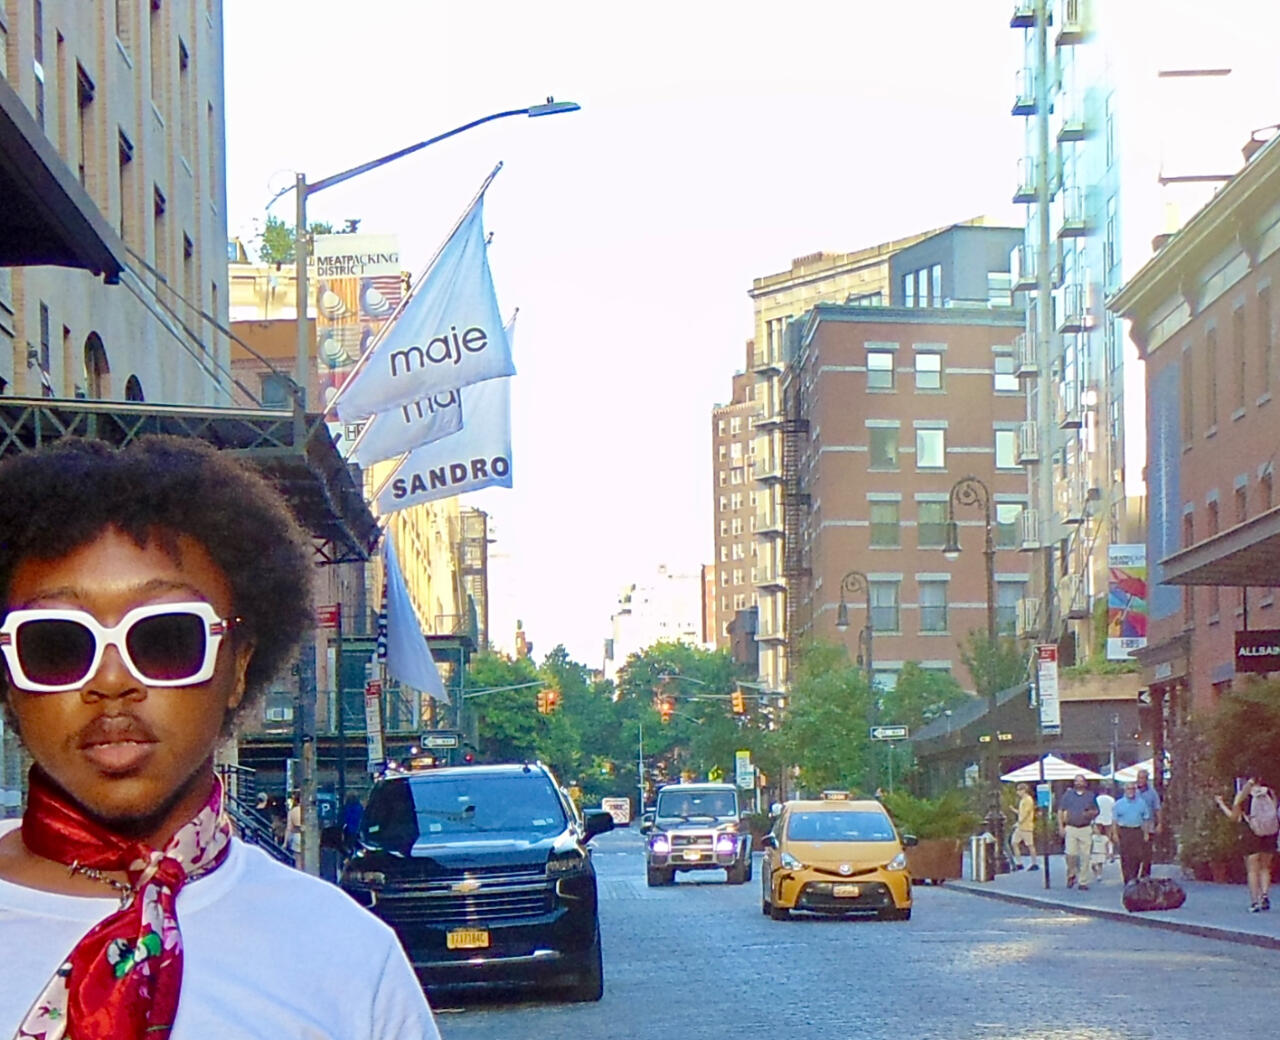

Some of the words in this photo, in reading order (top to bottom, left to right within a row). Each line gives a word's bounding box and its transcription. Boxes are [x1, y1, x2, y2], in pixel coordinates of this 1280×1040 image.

[317, 252, 399, 267] MEATPACKING
[317, 264, 365, 277] DISTRICT
[390, 325, 488, 376] maje
[392, 456, 509, 499] SANDRO
